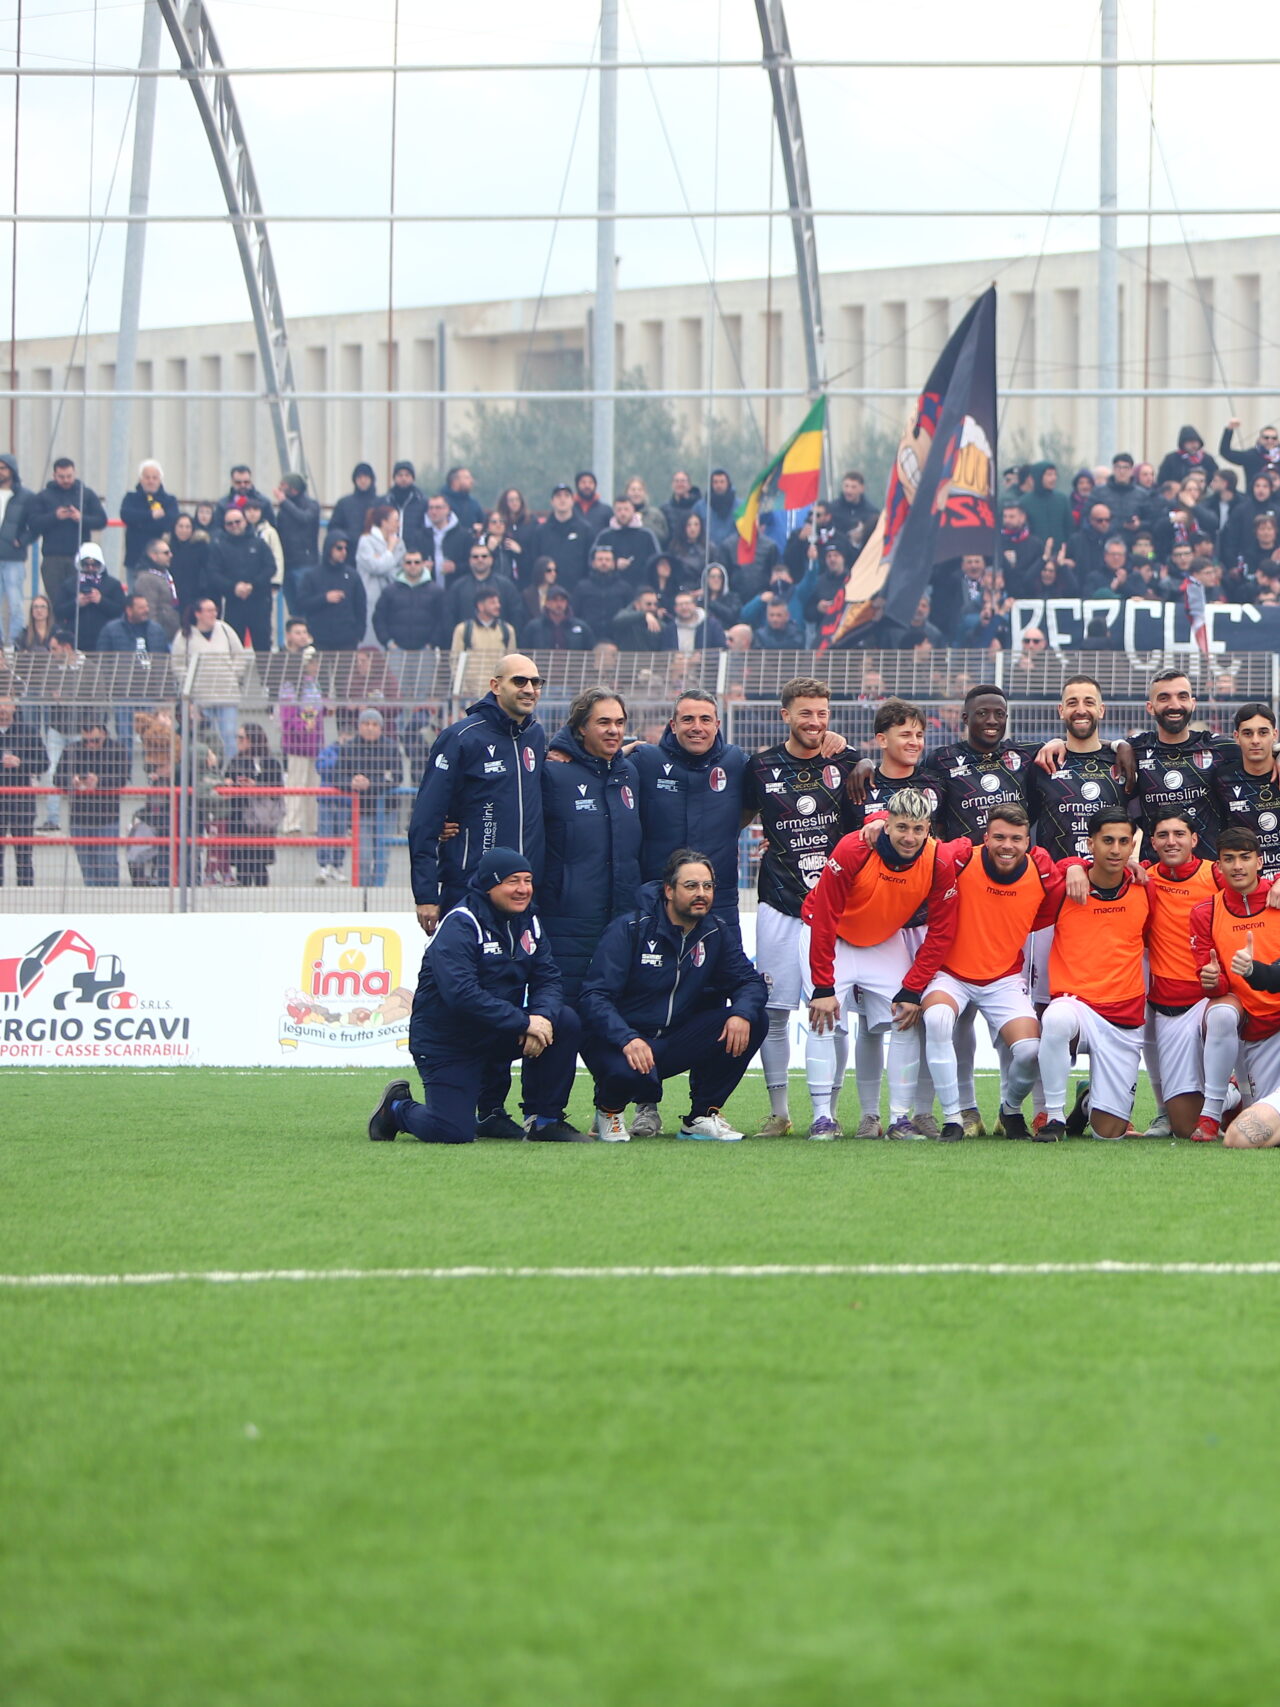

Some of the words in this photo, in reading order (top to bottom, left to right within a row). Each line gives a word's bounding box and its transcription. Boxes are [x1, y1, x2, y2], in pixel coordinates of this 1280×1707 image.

[961, 790, 1022, 809] ermeslink
[1145, 786, 1208, 803] ermeslink
[776, 812, 839, 830] ermeslink
[790, 833, 829, 848] siluce
[986, 886, 1017, 897] macron
[1159, 885, 1190, 896] macron
[1093, 905, 1126, 915] macron
[1232, 920, 1265, 932] macron
[312, 961, 390, 996] ima
[0, 1018, 83, 1041] RGIO
[93, 1017, 190, 1041] SCAVI
[283, 1022, 326, 1039] legumi
[329, 1031, 337, 1041] e
[340, 1030, 374, 1042] frutta
[55, 1044, 100, 1057] CASSE
[104, 1044, 189, 1057] SCARRABILI
